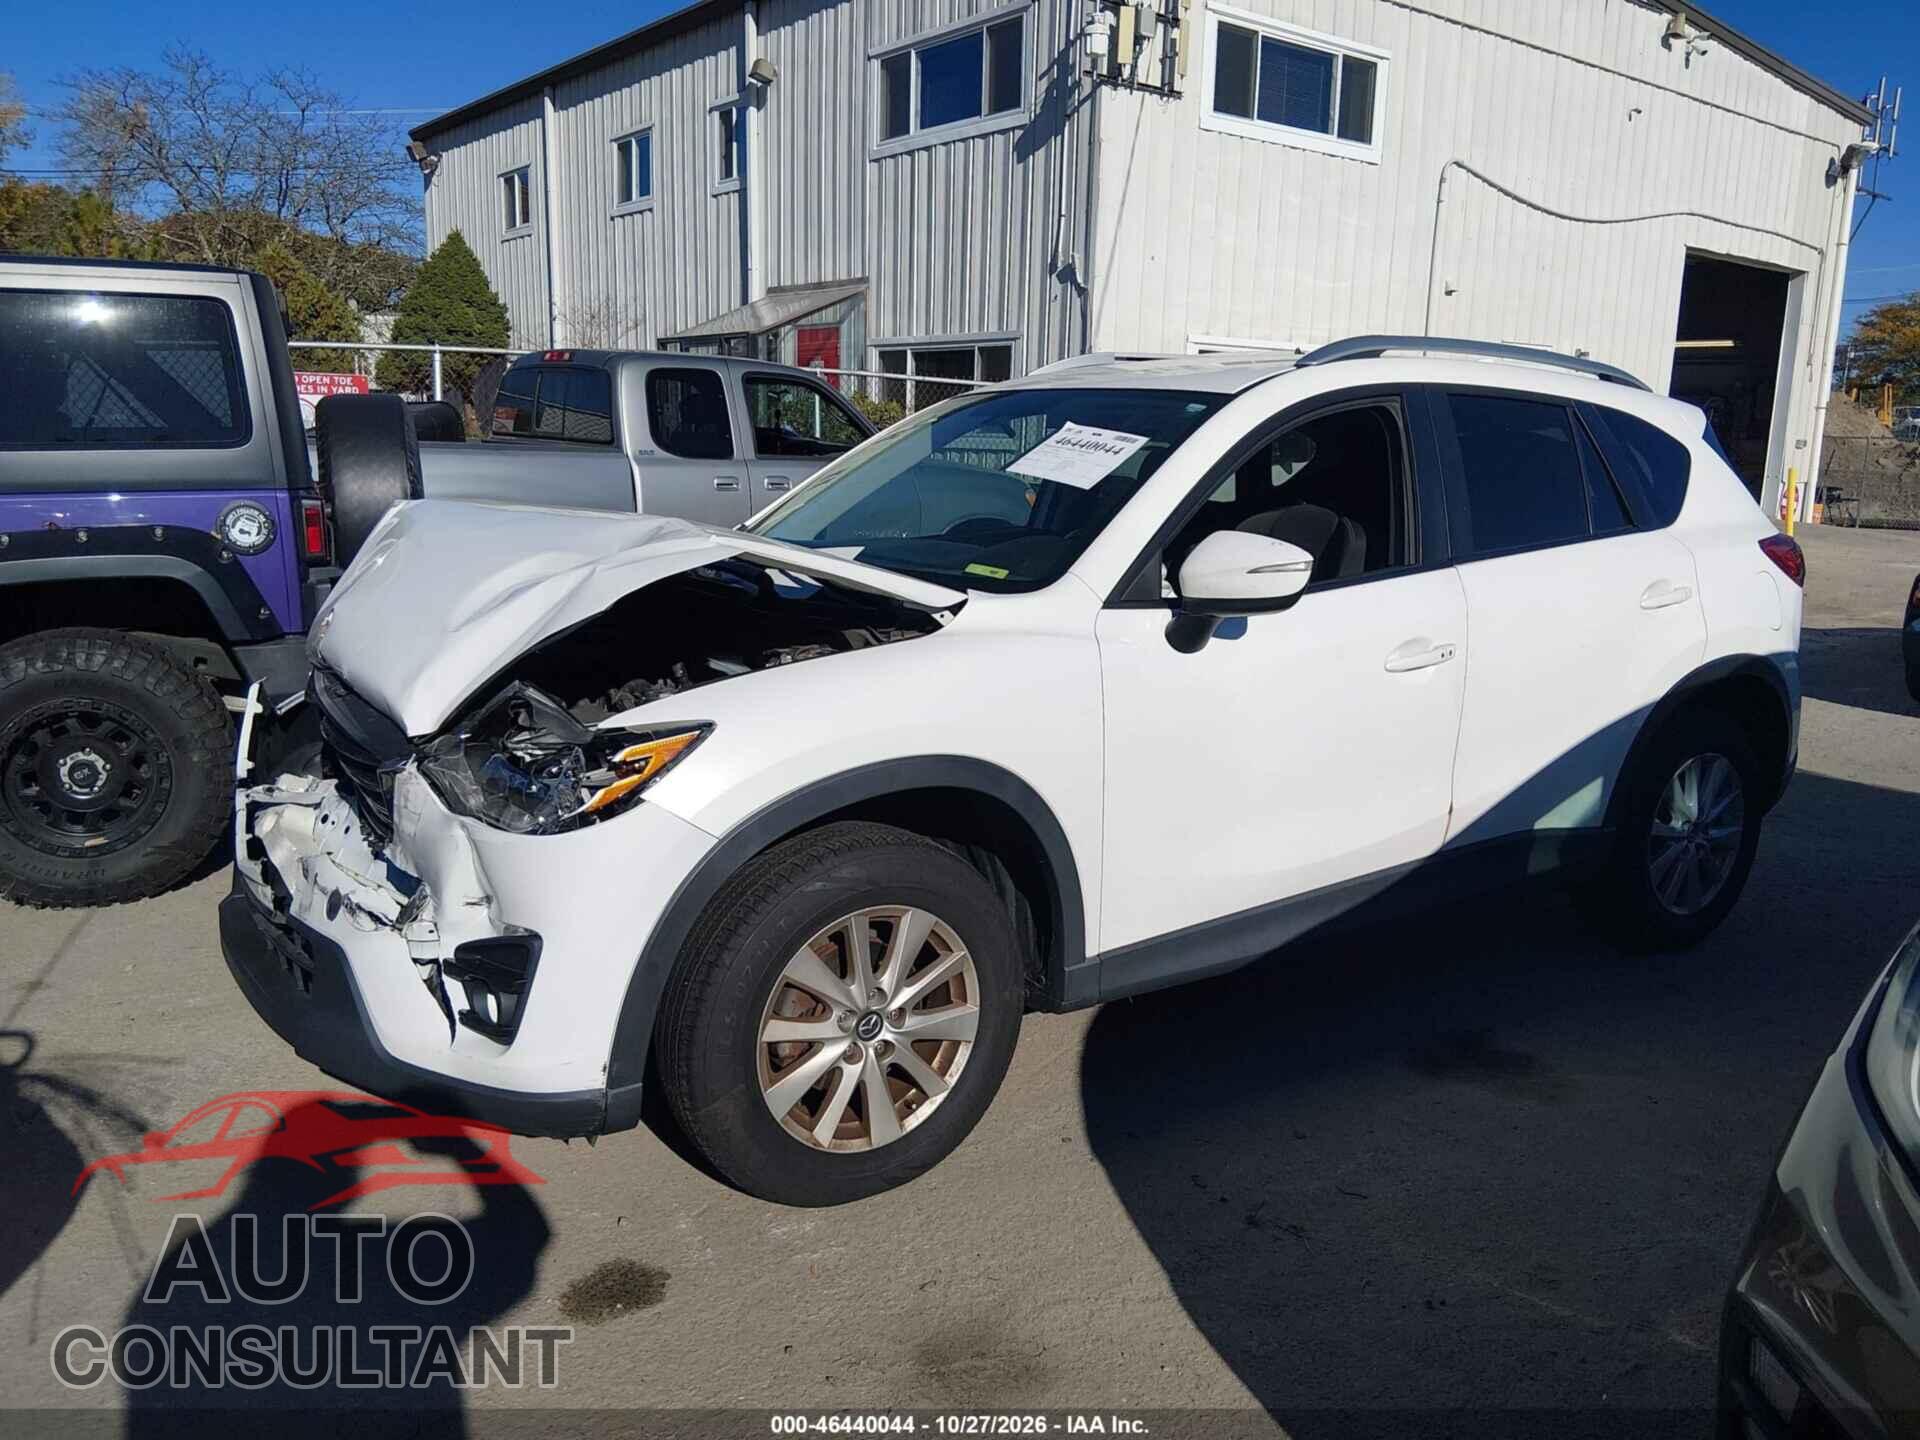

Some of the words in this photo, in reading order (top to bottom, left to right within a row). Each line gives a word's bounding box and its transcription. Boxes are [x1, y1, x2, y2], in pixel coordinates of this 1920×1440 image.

[301, 375, 330, 385] OPEN
[334, 376, 353, 386] TOE
[317, 385, 328, 394] IN
[330, 386, 359, 394] YARD
[1055, 435, 1125, 455] 46440044
